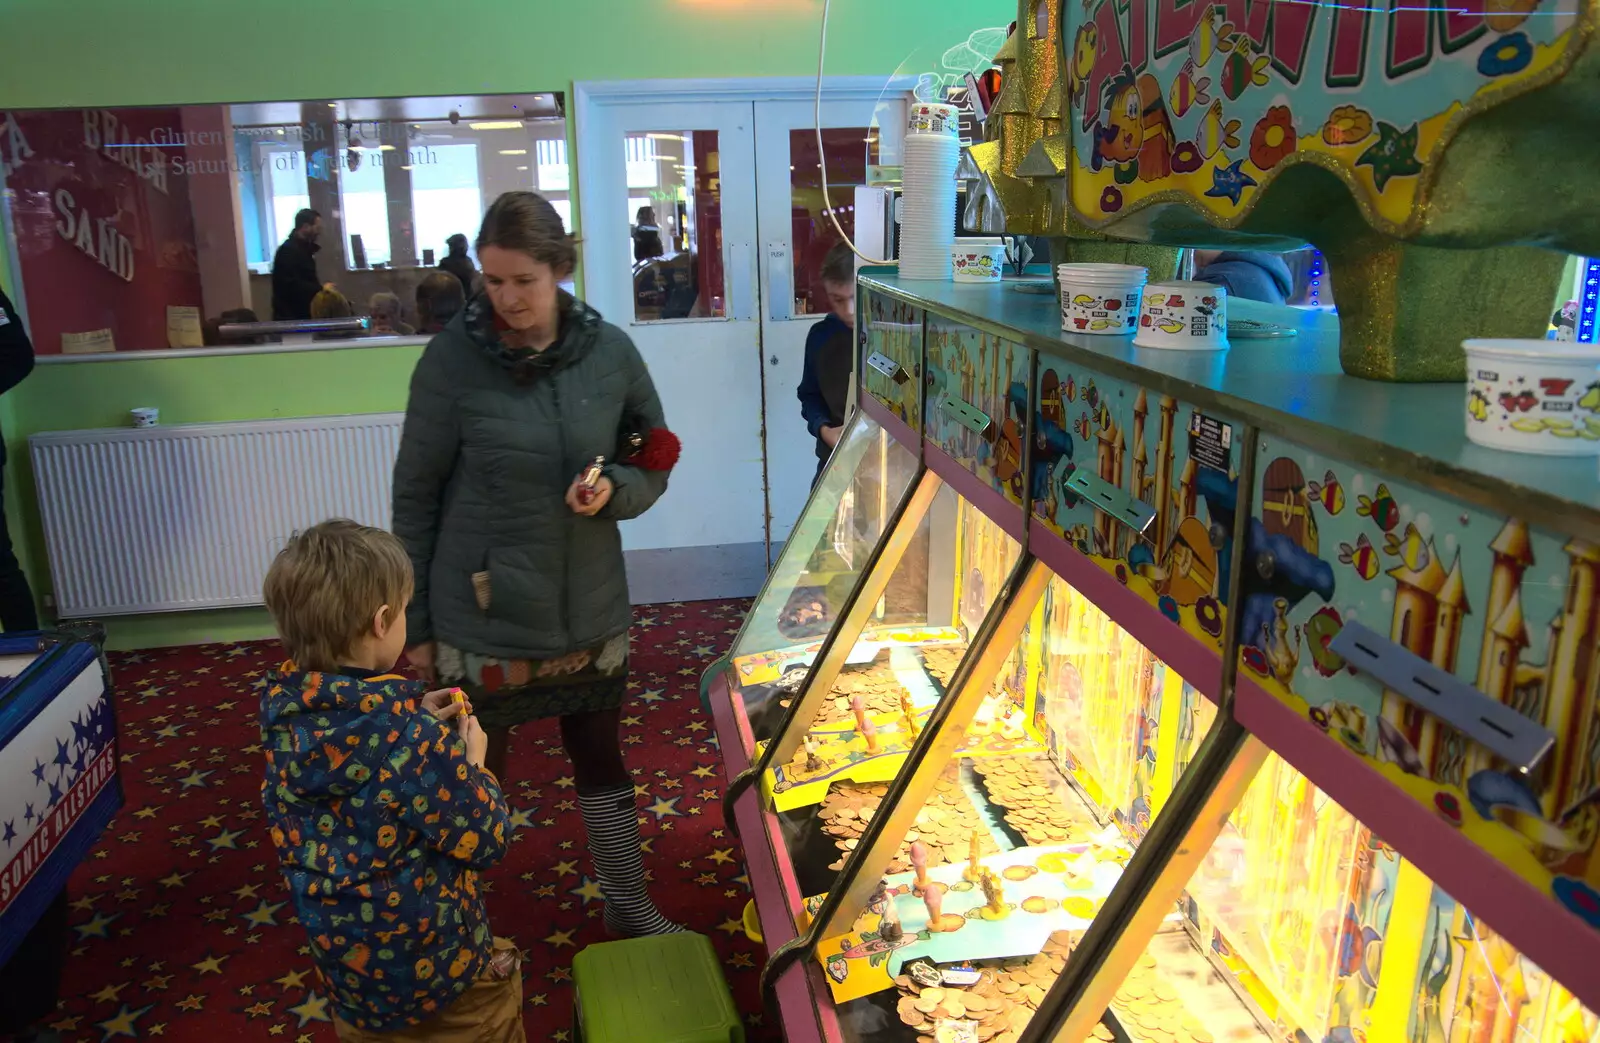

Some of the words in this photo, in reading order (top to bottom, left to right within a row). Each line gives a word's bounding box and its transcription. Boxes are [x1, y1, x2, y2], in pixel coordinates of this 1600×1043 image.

[82, 110, 169, 195] BEACH
[150, 127, 223, 146] Gluten
[171, 153, 265, 177] Saturday
[275, 151, 299, 171] of
[371, 146, 438, 167] month
[55, 188, 135, 282] SAND
[1, 826, 49, 901] SONIC
[55, 747, 114, 837] ALLSTARS
